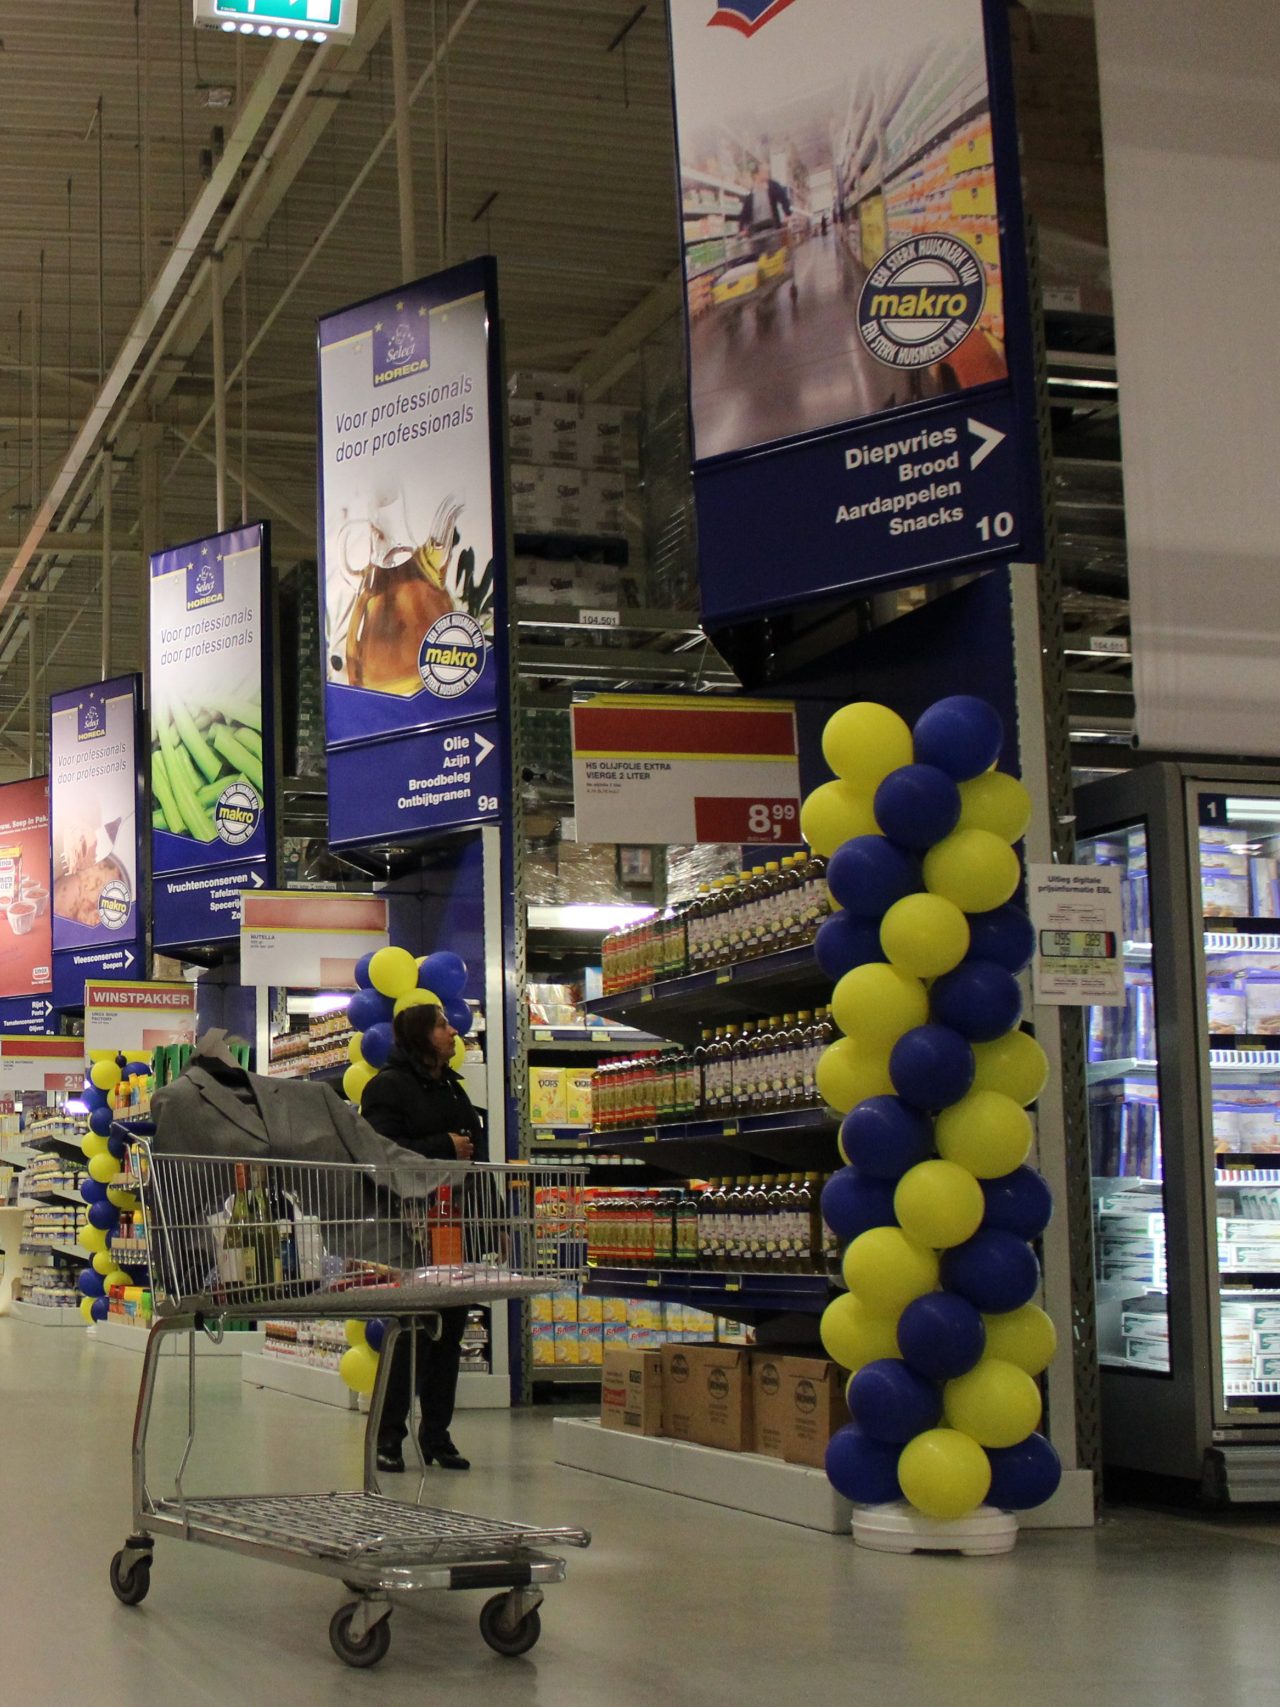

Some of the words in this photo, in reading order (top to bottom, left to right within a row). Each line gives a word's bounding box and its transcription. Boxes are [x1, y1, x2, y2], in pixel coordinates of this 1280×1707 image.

[869, 287, 968, 317] makro
[375, 358, 430, 385] HORECA
[335, 410, 368, 434] Voor
[371, 374, 473, 428] professionals
[335, 439, 369, 462] door
[372, 403, 474, 456] professionals
[845, 426, 958, 470] Diepvries
[899, 450, 960, 482] Brood
[835, 480, 962, 524] Aardappelen
[889, 506, 965, 536] Snacks
[976, 511, 1014, 541] 10
[187, 593, 224, 610] HORECA
[160, 627, 183, 644] Voor
[184, 606, 253, 641] professionals
[160, 648, 183, 666] door
[184, 629, 254, 661] professionals
[425, 646, 478, 668] makro
[58, 755, 75, 767] Voor
[76, 741, 127, 766] professionals
[443, 736, 470, 752] Olie
[57, 771, 75, 785] door
[76, 759, 128, 783] professionals
[443, 754, 470, 769] Azijn
[586, 762, 598, 770] HS
[599, 762, 639, 771] OLIJFOLIE
[643, 763, 672, 771] EXTRA
[408, 771, 471, 792] Broodbeleg
[626, 772, 651, 780] LITER
[397, 788, 471, 810] Ontbijtgranen
[477, 795, 498, 812] 9a
[1207, 802, 1216, 818] 1
[218, 806, 255, 824] makro
[747, 804, 796, 839] 8,99
[167, 872, 248, 894] Vruchtenconserven
[100, 897, 127, 914] makro
[73, 951, 123, 965] Vleesconserven
[93, 991, 190, 1005] WINSTPAKKER
